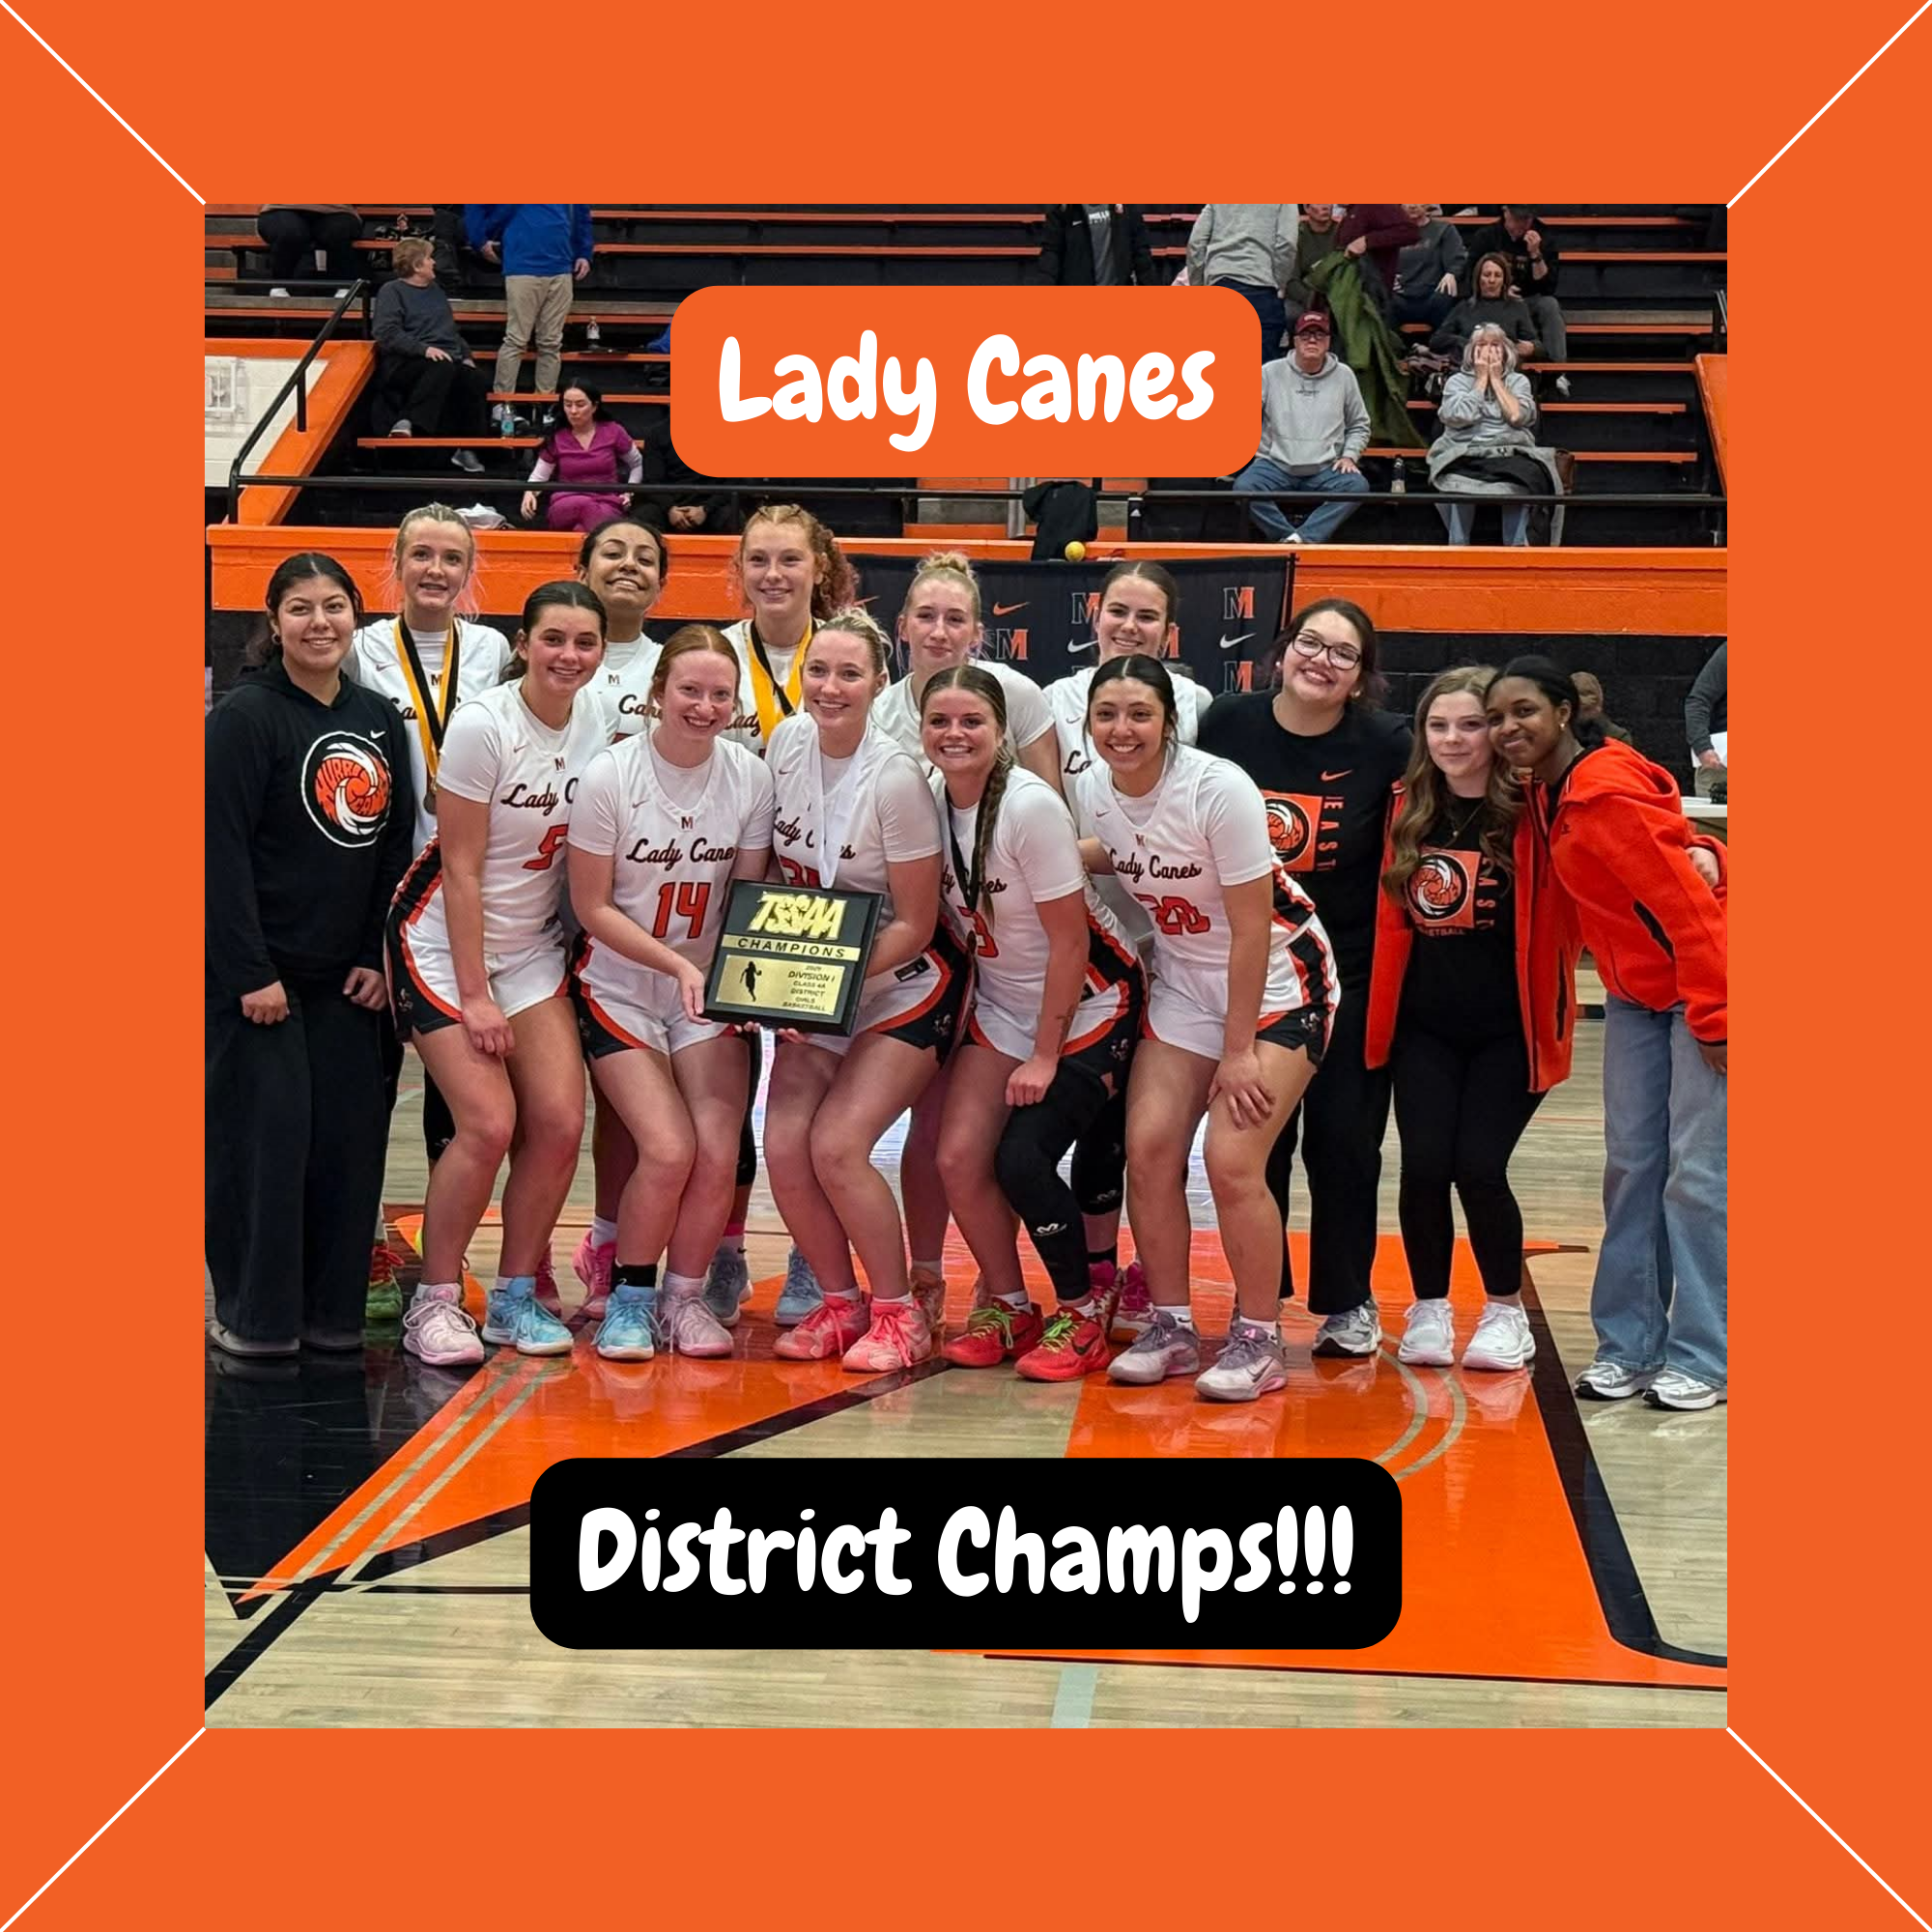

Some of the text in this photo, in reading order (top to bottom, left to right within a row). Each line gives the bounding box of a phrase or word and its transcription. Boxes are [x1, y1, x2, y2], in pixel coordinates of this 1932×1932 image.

[500, 782, 559, 817] Lady
[681, 816, 694, 830] M
[1317, 801, 1345, 867] EAST
[522, 823, 569, 870] 5
[625, 838, 683, 871] Lady
[1150, 855, 1203, 879] Canes
[652, 882, 712, 939] 14
[747, 891, 848, 941] TSSAA
[1132, 893, 1210, 935] 20
[738, 937, 846, 959] CHAMPIONS
[787, 970, 831, 981] DIVISION
[790, 987, 826, 997] DISTRICT
